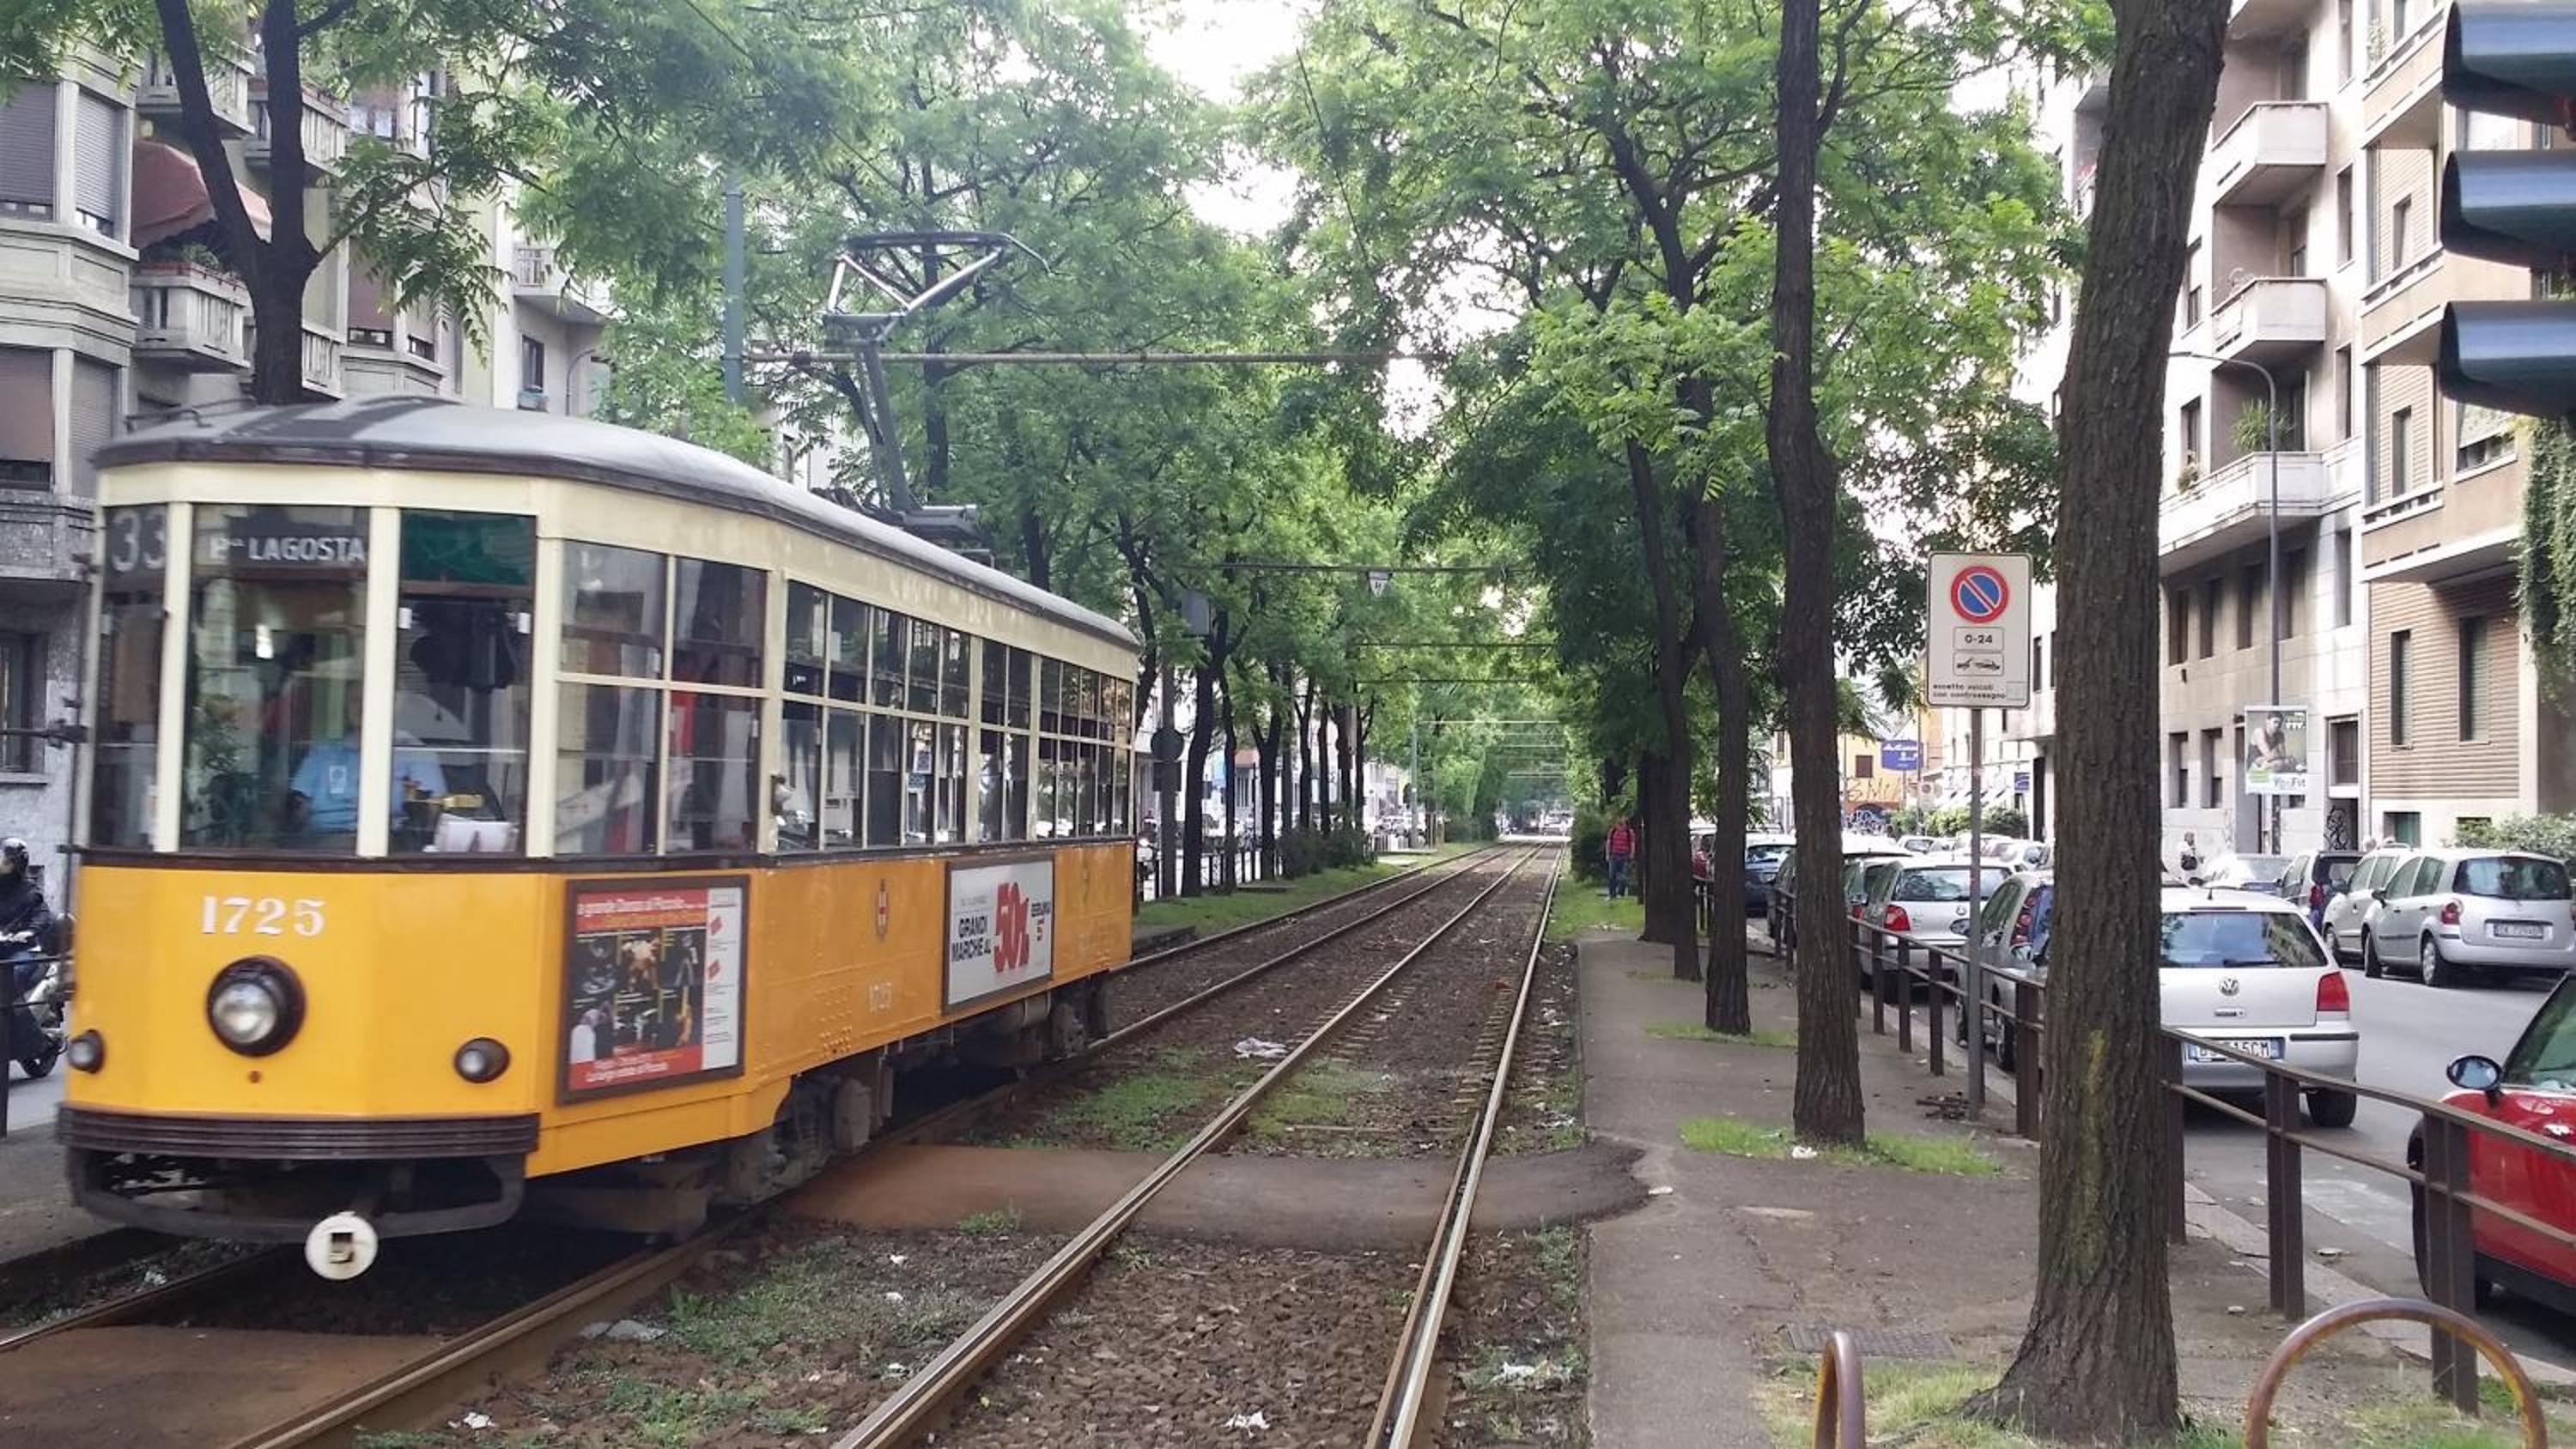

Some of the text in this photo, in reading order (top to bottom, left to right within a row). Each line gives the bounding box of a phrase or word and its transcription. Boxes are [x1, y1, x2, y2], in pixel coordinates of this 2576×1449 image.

[112, 508, 166, 573] 33
[247, 537, 365, 562] LAGOSTA
[1964, 634, 1993, 645] 0-24
[201, 894, 326, 937] 1725
[958, 915, 988, 938] GRANDI
[951, 937, 983, 962] MARCHE
